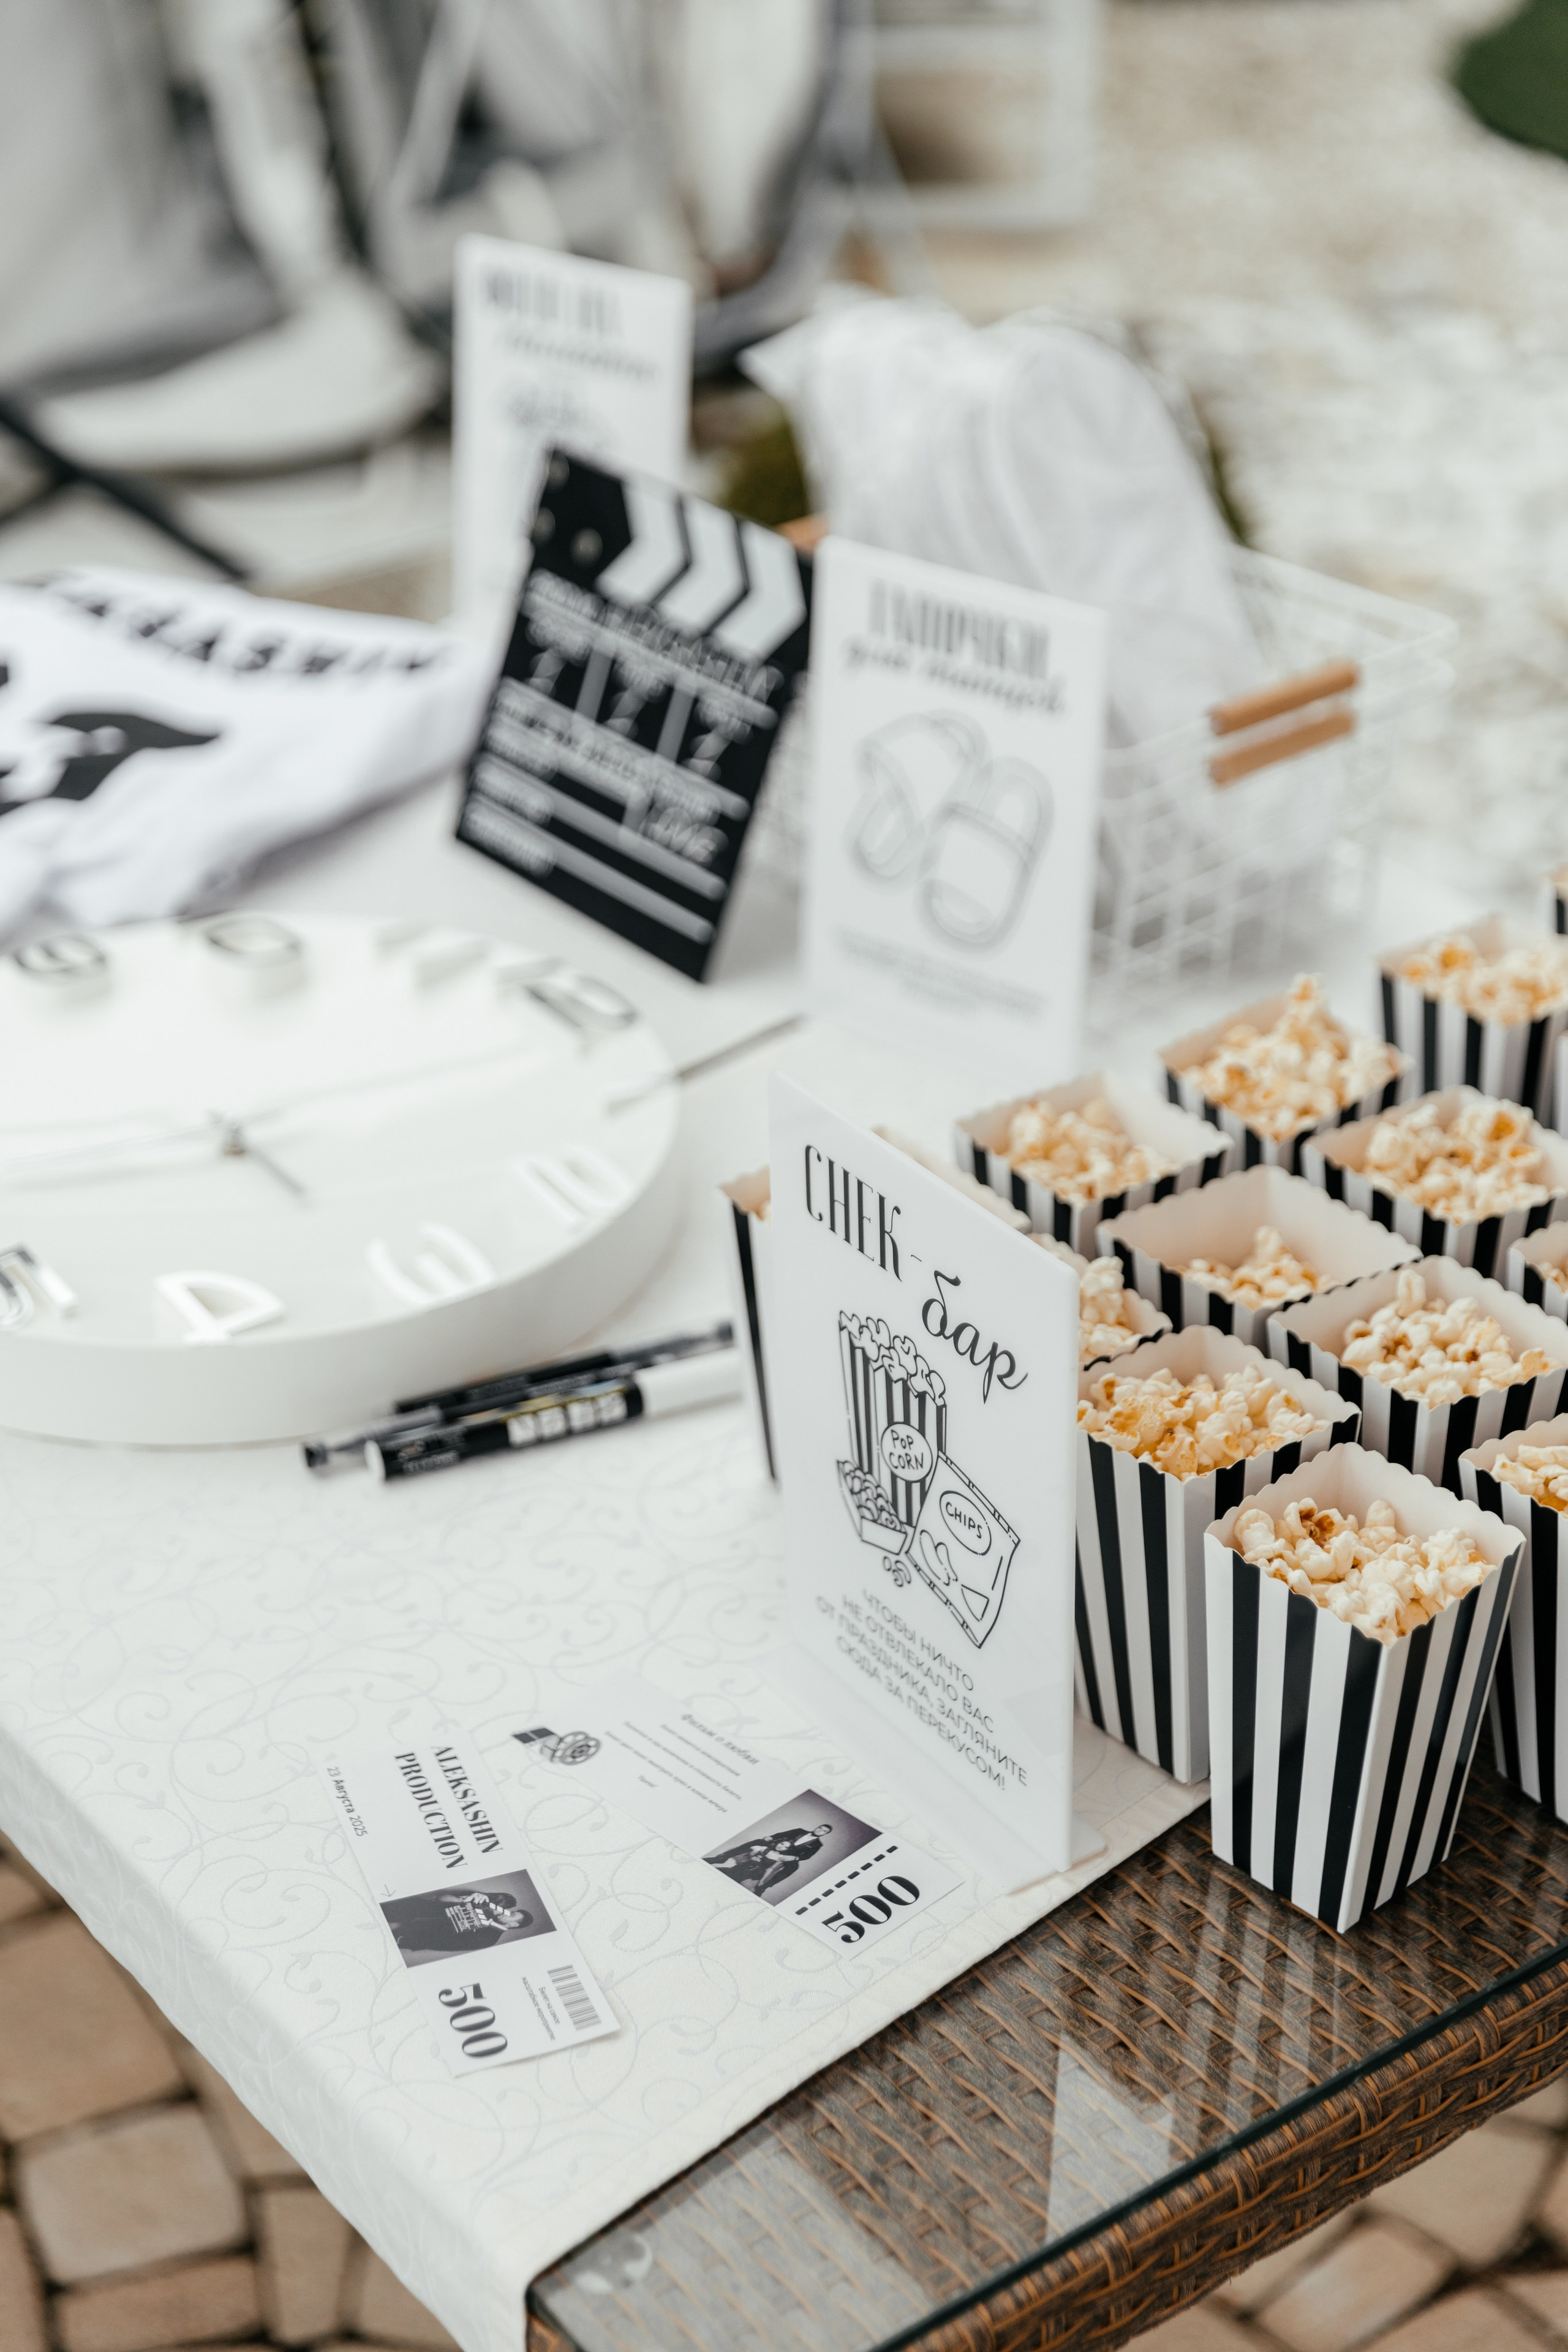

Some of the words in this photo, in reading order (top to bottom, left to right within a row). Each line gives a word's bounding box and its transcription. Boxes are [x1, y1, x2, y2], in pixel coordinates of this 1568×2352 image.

[922, 1270, 1029, 1404] бар
[889, 1452, 923, 1470] CORN
[946, 1502, 982, 1539] CHIPS
[842, 1593, 863, 1621] НЕ
[865, 1615, 959, 1701] ОТВЛЕКАЛО
[963, 1696, 993, 1733] ВАС
[862, 1588, 916, 1645] ЧТОБЫ
[920, 1636, 974, 1691] НИЧТО
[815, 1595, 837, 1619] ОТ
[936, 1697, 1028, 1787] ЗАГЛЯНИТЕ
[835, 1635, 883, 1684] СЮДА
[884, 1675, 905, 1703] ЗА
[907, 1694, 1005, 1791] ПЕРЕКУСОМ!
[326, 1766, 341, 1777] 23
[332, 1779, 355, 1813] Августа
[430, 1746, 503, 1853] ALEKSASHIN
[349, 1815, 368, 1836] 2025
[394, 1752, 467, 1869] PRODUCTION
[821, 1875, 919, 1943] 500
[439, 1983, 508, 2059] 500
[539, 1986, 550, 2002] Билет
